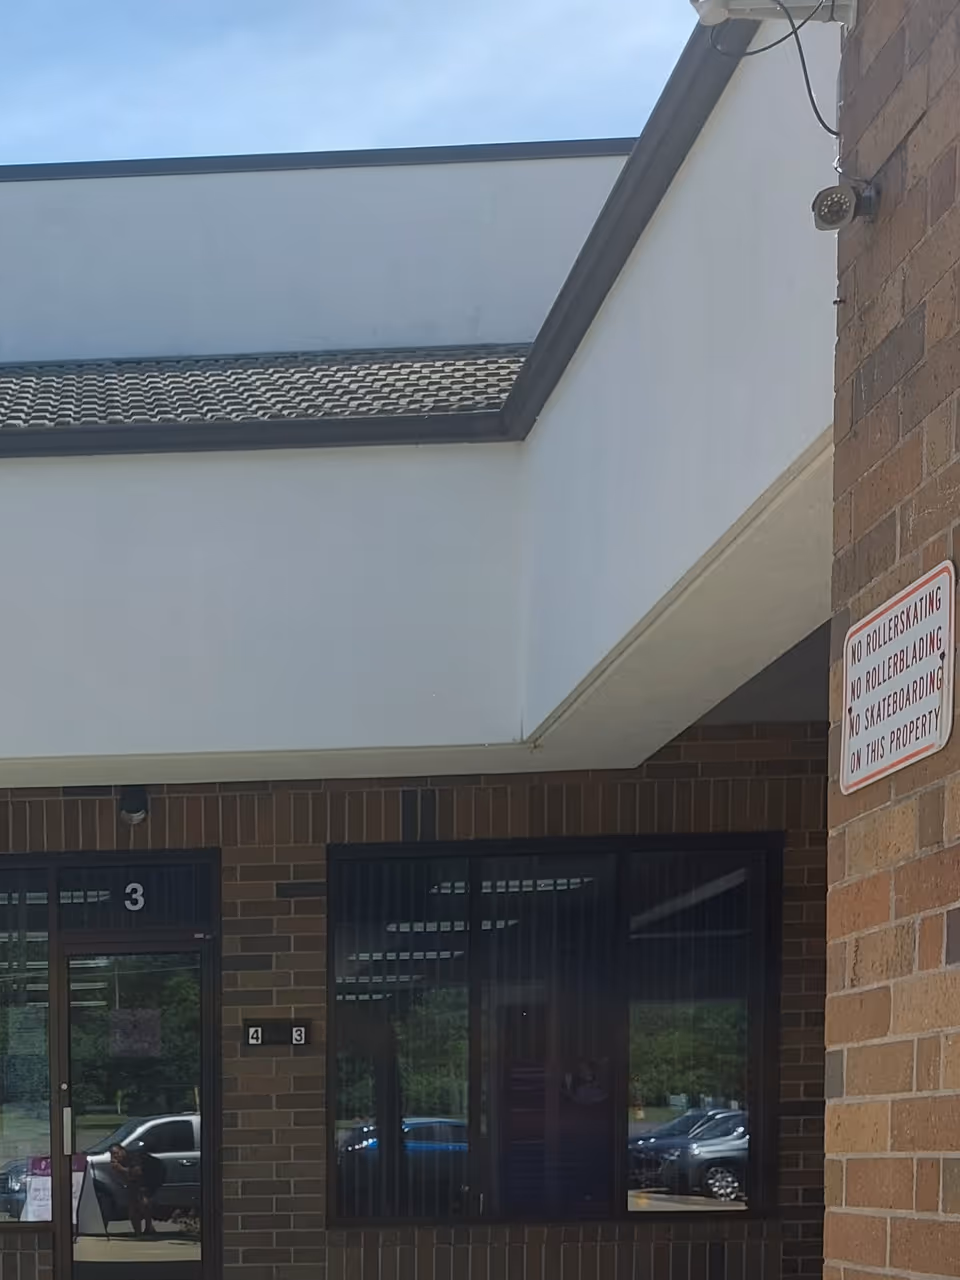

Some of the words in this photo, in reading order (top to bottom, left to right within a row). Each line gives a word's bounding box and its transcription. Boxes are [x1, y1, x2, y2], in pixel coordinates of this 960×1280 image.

[851, 640, 862, 666] NO
[866, 586, 941, 656] ROLLERSKATING
[850, 676, 862, 702] NO
[865, 626, 942, 694] ROLLERBLADING
[849, 713, 860, 740] NO
[864, 666, 942, 730] SKATEBOARDING
[850, 748, 862, 774] ON
[866, 735, 885, 766] THIS
[889, 704, 940, 754] PROPERTY
[124, 882, 145, 910] 3
